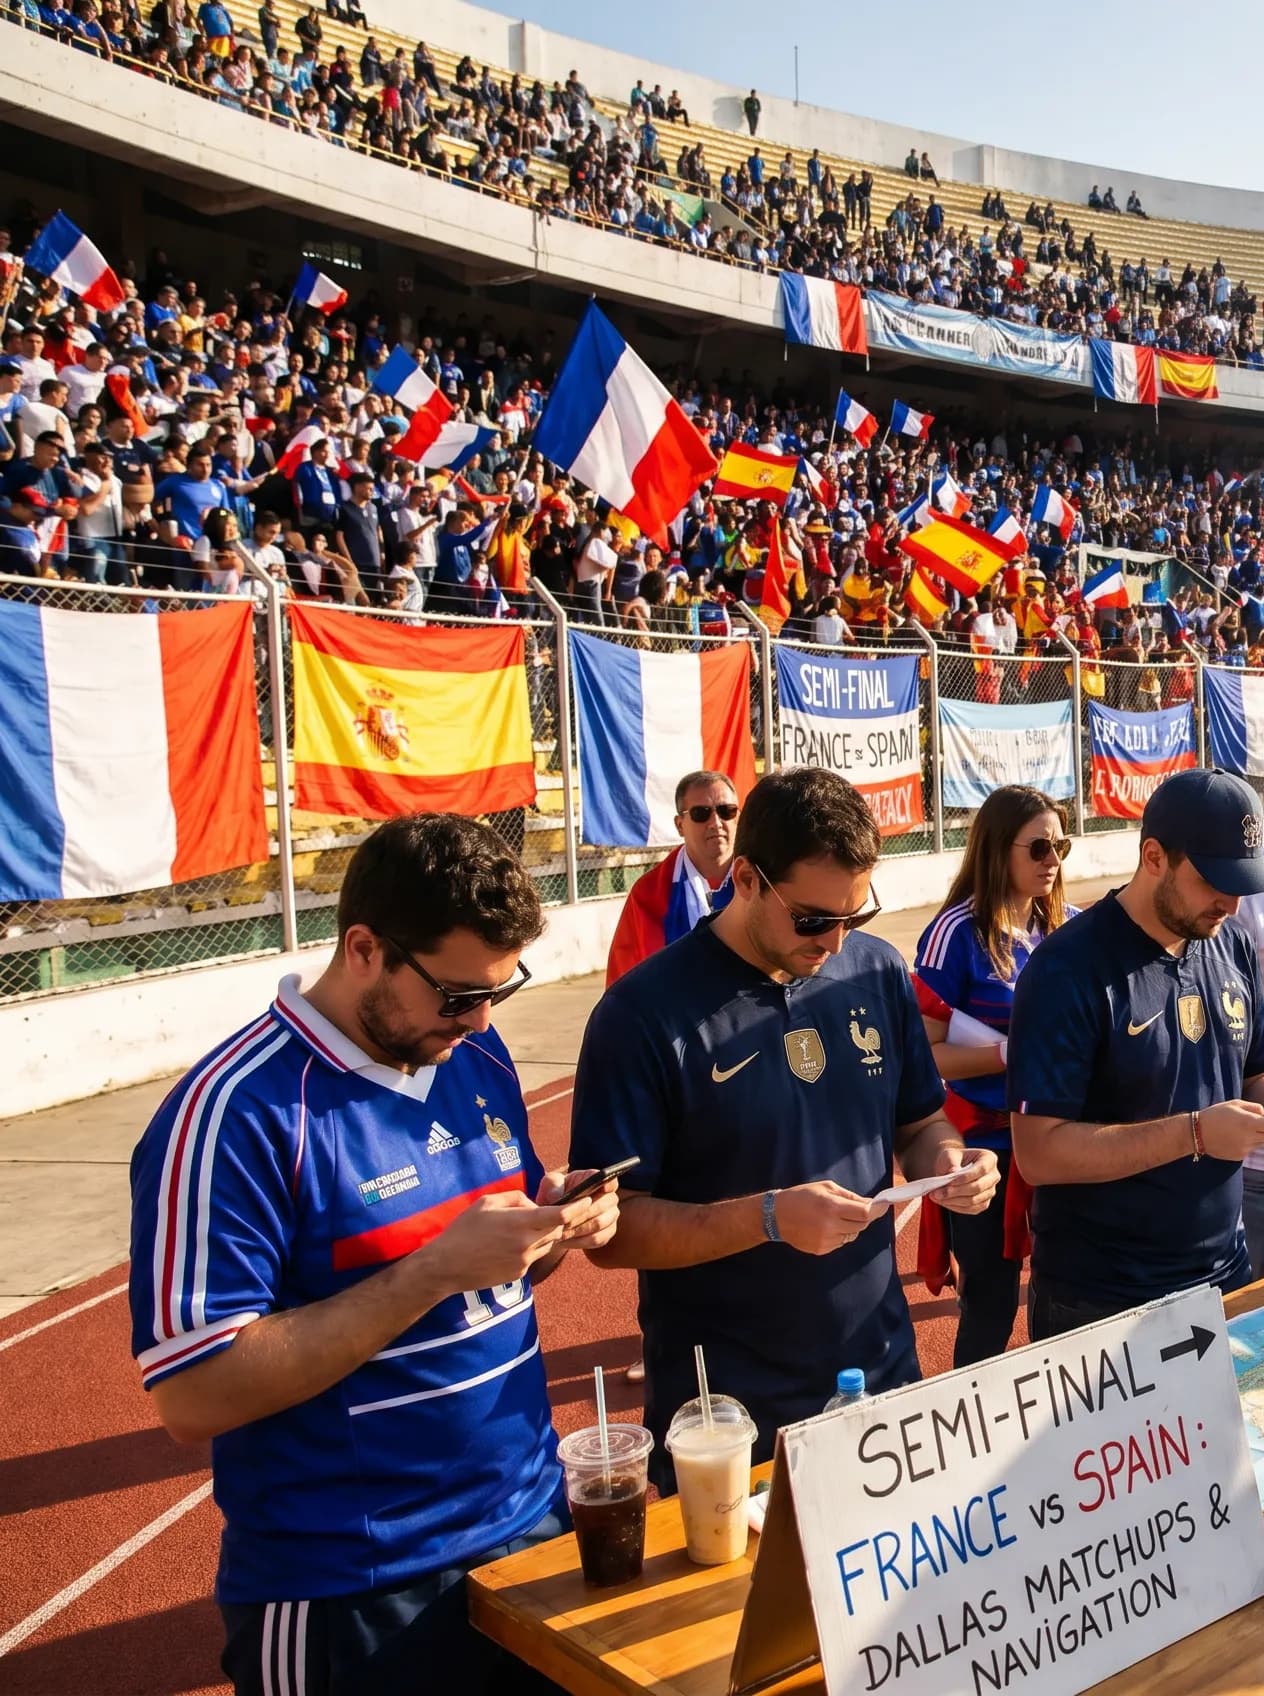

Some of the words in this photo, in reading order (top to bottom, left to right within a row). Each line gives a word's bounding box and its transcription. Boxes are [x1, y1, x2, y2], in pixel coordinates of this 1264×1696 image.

[800, 663, 895, 710] SEMI-FINAL
[782, 723, 852, 769] FRANCE
[836, 1484, 1018, 1617] FRANCE
[1029, 1493, 1065, 1530] vs
[858, 1589, 1008, 1692] DALLAS
[1024, 1501, 1196, 1614] MATCHUPS
[1208, 1482, 1231, 1530] &
